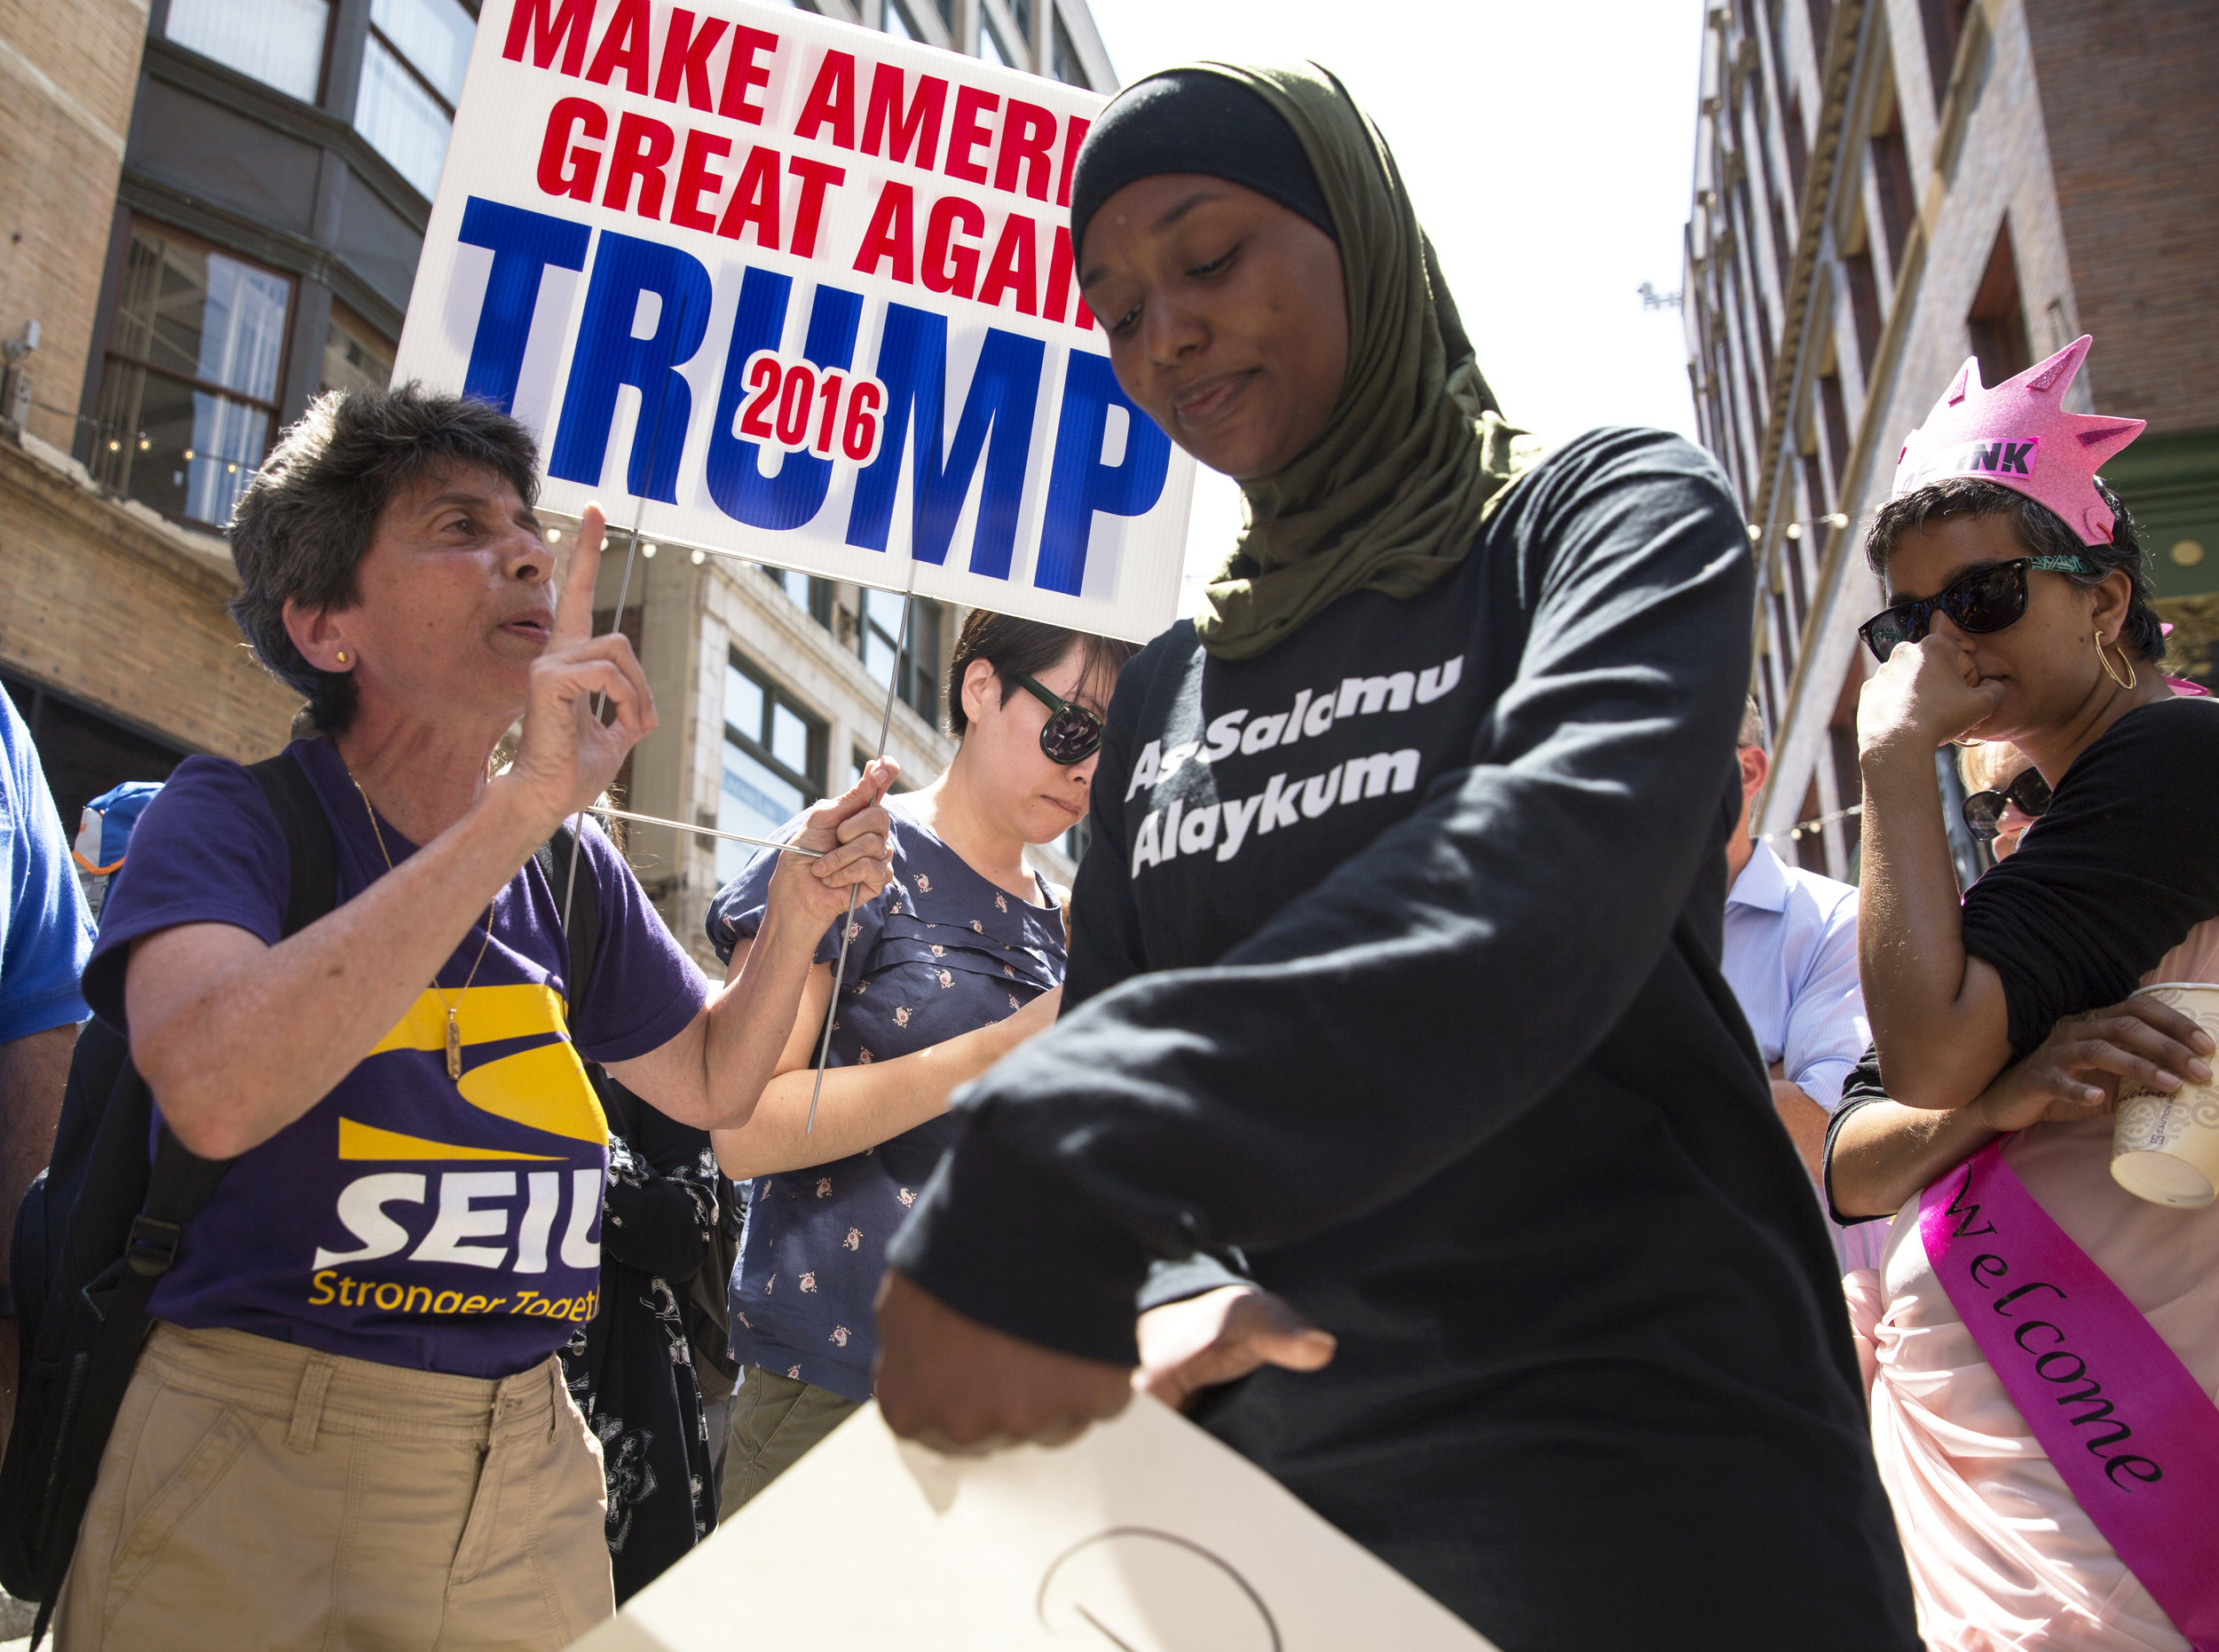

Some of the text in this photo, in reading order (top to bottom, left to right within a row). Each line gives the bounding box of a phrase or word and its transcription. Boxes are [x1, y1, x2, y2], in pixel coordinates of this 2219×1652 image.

[502, 0, 779, 126] MAKE
[536, 97, 1096, 331] GREAT AGAI
[458, 195, 1172, 597] TRUMP
[740, 358, 881, 461] 2016
[1132, 747, 1421, 880] Alaykum
[2156, 1104, 2173, 1134] CAUTION
